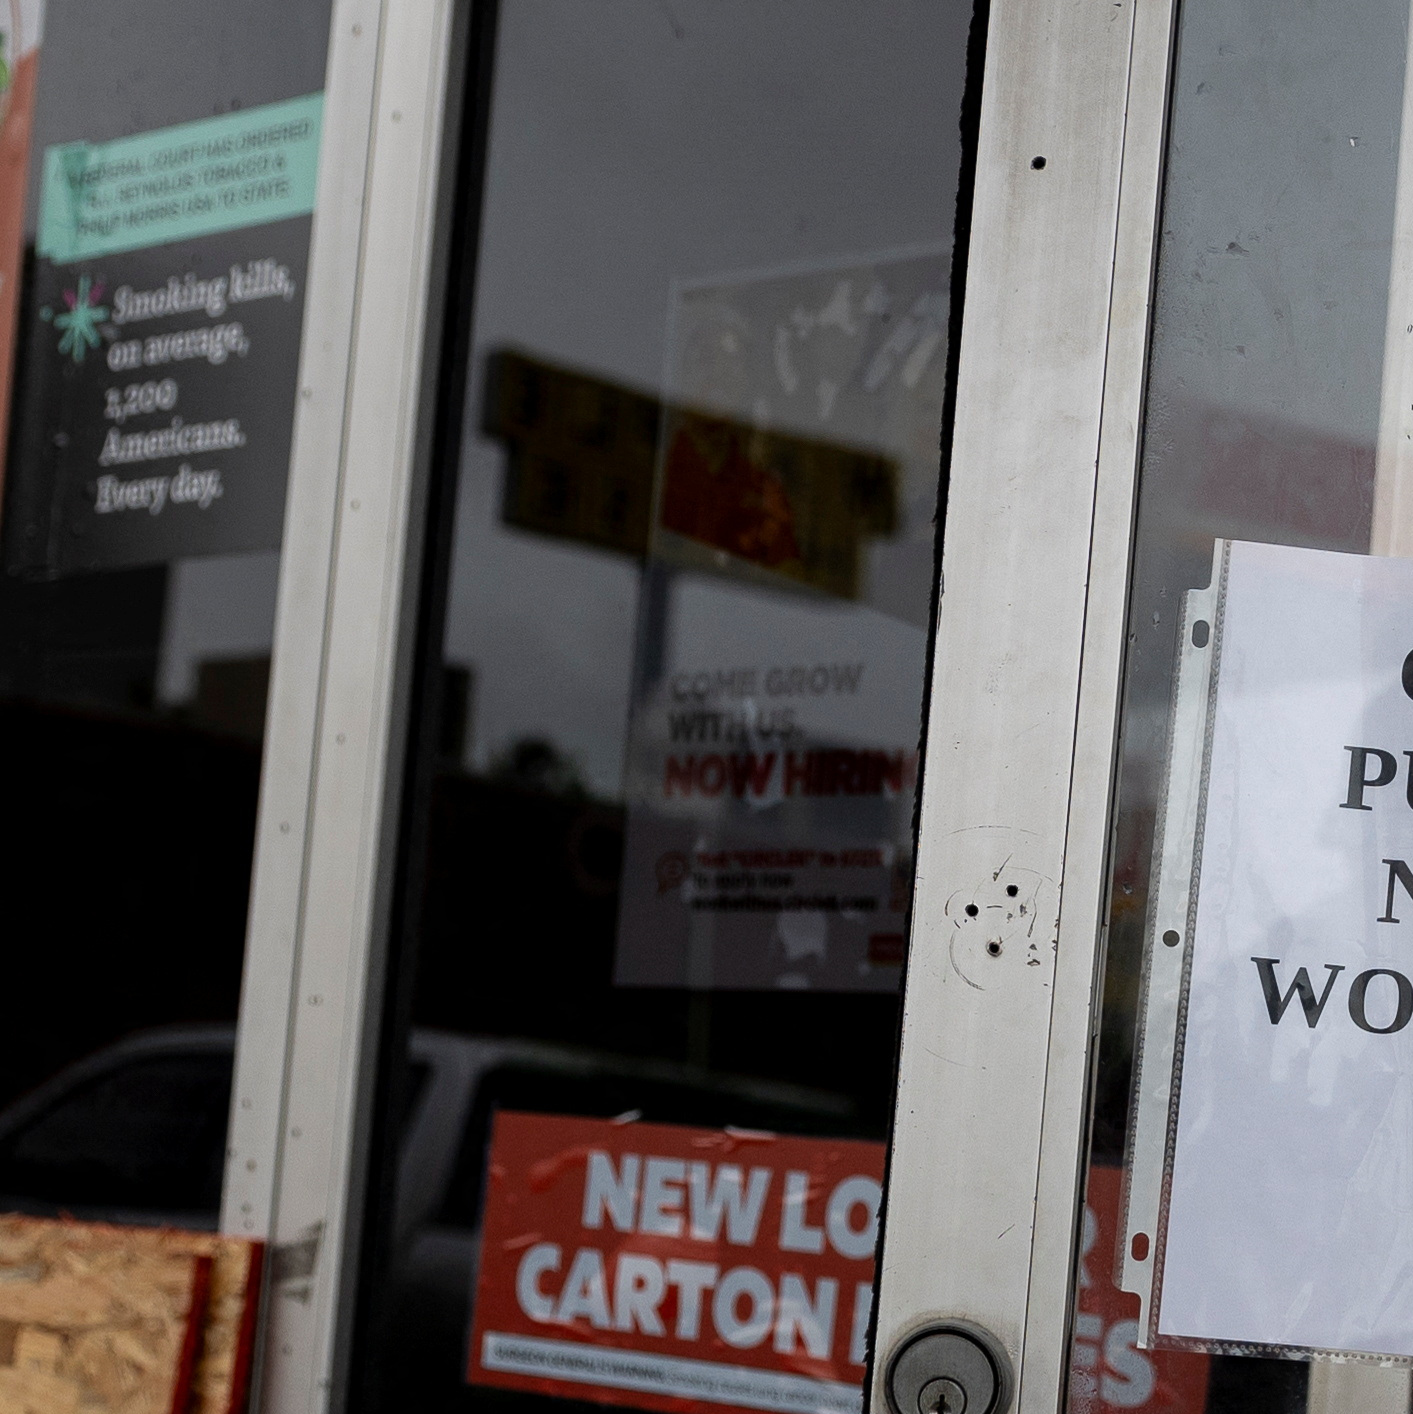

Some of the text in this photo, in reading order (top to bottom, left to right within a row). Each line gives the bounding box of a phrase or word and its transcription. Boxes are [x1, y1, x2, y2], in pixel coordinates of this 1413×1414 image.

[112, 257, 295, 324] Smoking kills,
[107, 322, 250, 372] on average,
[98, 416, 247, 466] Americans.
[95, 463, 224, 515] Every day.
[671, 663, 864, 702] COME GROW
[664, 752, 777, 798] NOW
[581, 1150, 772, 1242] NEW
[515, 1243, 837, 1363] CARTON
